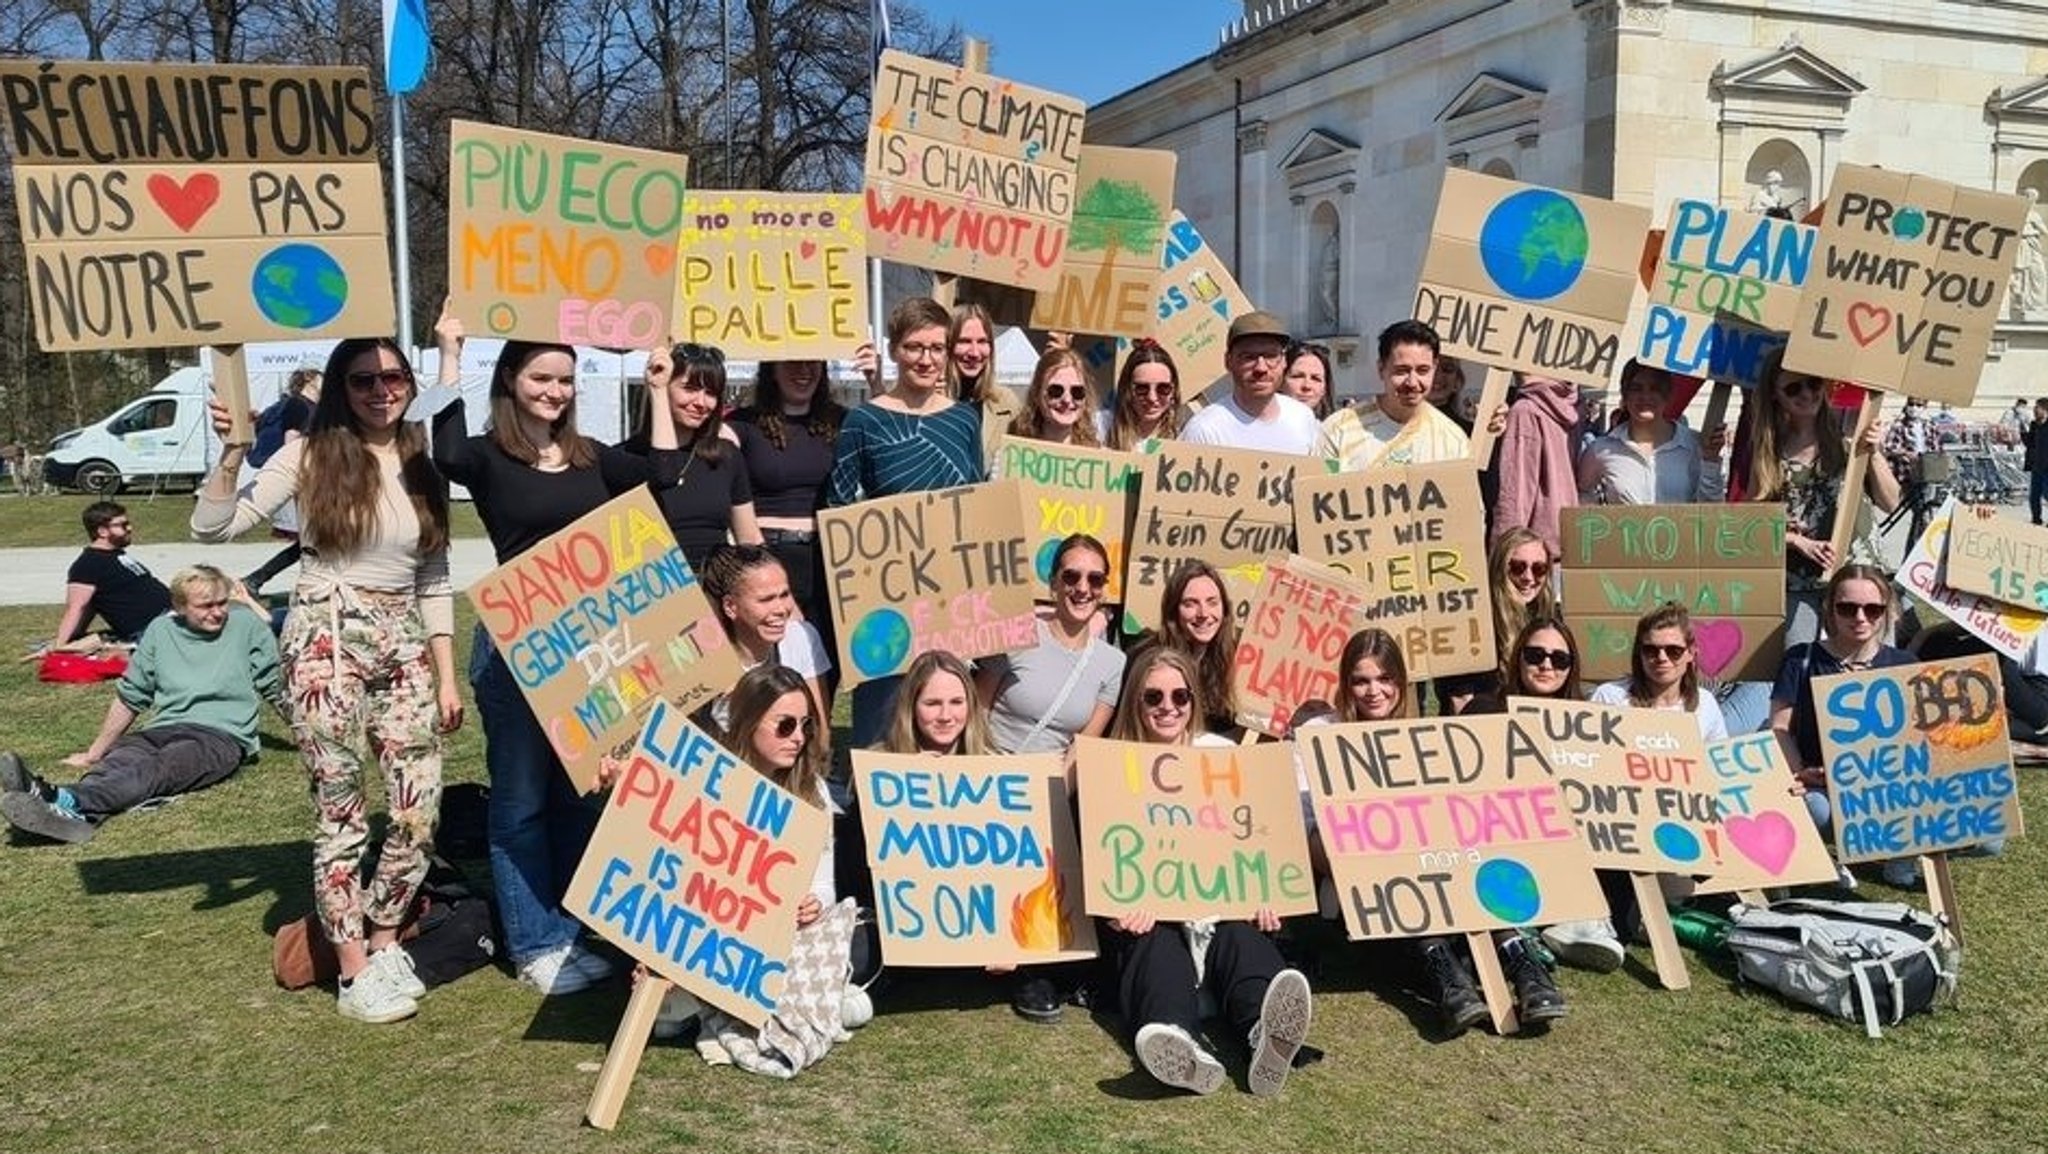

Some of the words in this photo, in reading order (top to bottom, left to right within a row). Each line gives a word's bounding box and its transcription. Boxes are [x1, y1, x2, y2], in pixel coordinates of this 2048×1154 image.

[1, 62, 374, 162] RÉCHAUFFONS
[885, 65, 954, 119] THE
[957, 86, 1083, 163] CLIMATE
[455, 140, 549, 213] PIÙ
[558, 152, 685, 237] ECO
[878, 134, 907, 176] IS
[922, 145, 1069, 215] CHANGING
[27, 170, 135, 239] NOS
[249, 170, 346, 234] PAS
[696, 213, 729, 230] no
[753, 211, 834, 227] more
[866, 189, 955, 242] WHY
[954, 210, 1031, 257] NOT
[1034, 225, 1063, 268] U
[463, 221, 621, 301] MENO
[1669, 200, 1817, 286] PLAN
[35, 249, 223, 345] NOTRE
[685, 248, 851, 295] PILLE
[1667, 263, 1767, 321] FOR
[1827, 245, 1919, 290] WHAT
[1925, 268, 1995, 309] YOU
[559, 300, 662, 347] EGO
[691, 300, 855, 343] PALLE
[1414, 287, 1508, 356] DEINE
[1514, 313, 1620, 378] MUDDA
[1003, 443, 1100, 490] PROTECT
[1155, 453, 1240, 497] Kohle
[1257, 462, 1296, 506] ist
[825, 487, 975, 568] DON'T
[1039, 498, 1106, 534] YOU
[1147, 506, 1206, 547] kein
[1313, 479, 1447, 524] KLIMA
[952, 538, 1029, 589] THE
[1324, 528, 1371, 556] IST
[1394, 518, 1444, 545] WIE
[1576, 513, 1785, 563] PROTECT
[481, 531, 610, 643] SIAMO
[609, 506, 671, 573] LA
[1268, 566, 1361, 626] THERE
[1328, 551, 1466, 592] IER
[1602, 574, 1756, 614] WHAT
[510, 549, 695, 689] GENERAZIONE
[1255, 602, 1284, 639] IS
[1294, 614, 1350, 662] NO
[1365, 594, 1428, 621] WARM
[1438, 588, 1479, 614] IST
[1967, 599, 2022, 650] Future
[575, 622, 650, 686] DEL
[1586, 621, 1632, 663] YO
[1517, 704, 1626, 747] UCK
[1636, 733, 1680, 751] each
[1827, 678, 1904, 745] SO
[641, 702, 735, 800] LIFE
[747, 781, 793, 839] IN
[1125, 749, 1241, 797] ICH
[1312, 736, 1332, 796] I
[1336, 723, 1483, 791] NEED
[1506, 720, 1553, 779] A
[1551, 748, 1600, 768] ther
[1625, 753, 1697, 785] BUT
[1708, 736, 1775, 778] ECT
[1833, 740, 1930, 786] EVEN
[870, 770, 1032, 811] DEINE
[1840, 764, 2014, 819] INTROVERTS
[616, 757, 796, 905] PLASTIC
[878, 818, 1044, 869] MUDDA
[1325, 796, 1432, 854] HOT
[1448, 787, 1571, 847] DATE
[1577, 819, 1640, 854] HE
[1844, 815, 1909, 855] ARE
[1913, 801, 2005, 847] HERE
[1419, 852, 1460, 868] not
[649, 847, 683, 891] IS
[685, 872, 766, 932] NOT
[880, 879, 924, 938] IS
[934, 884, 995, 938] ON
[1351, 872, 1454, 935] HOT
[588, 857, 787, 1009] FANTASTIC
